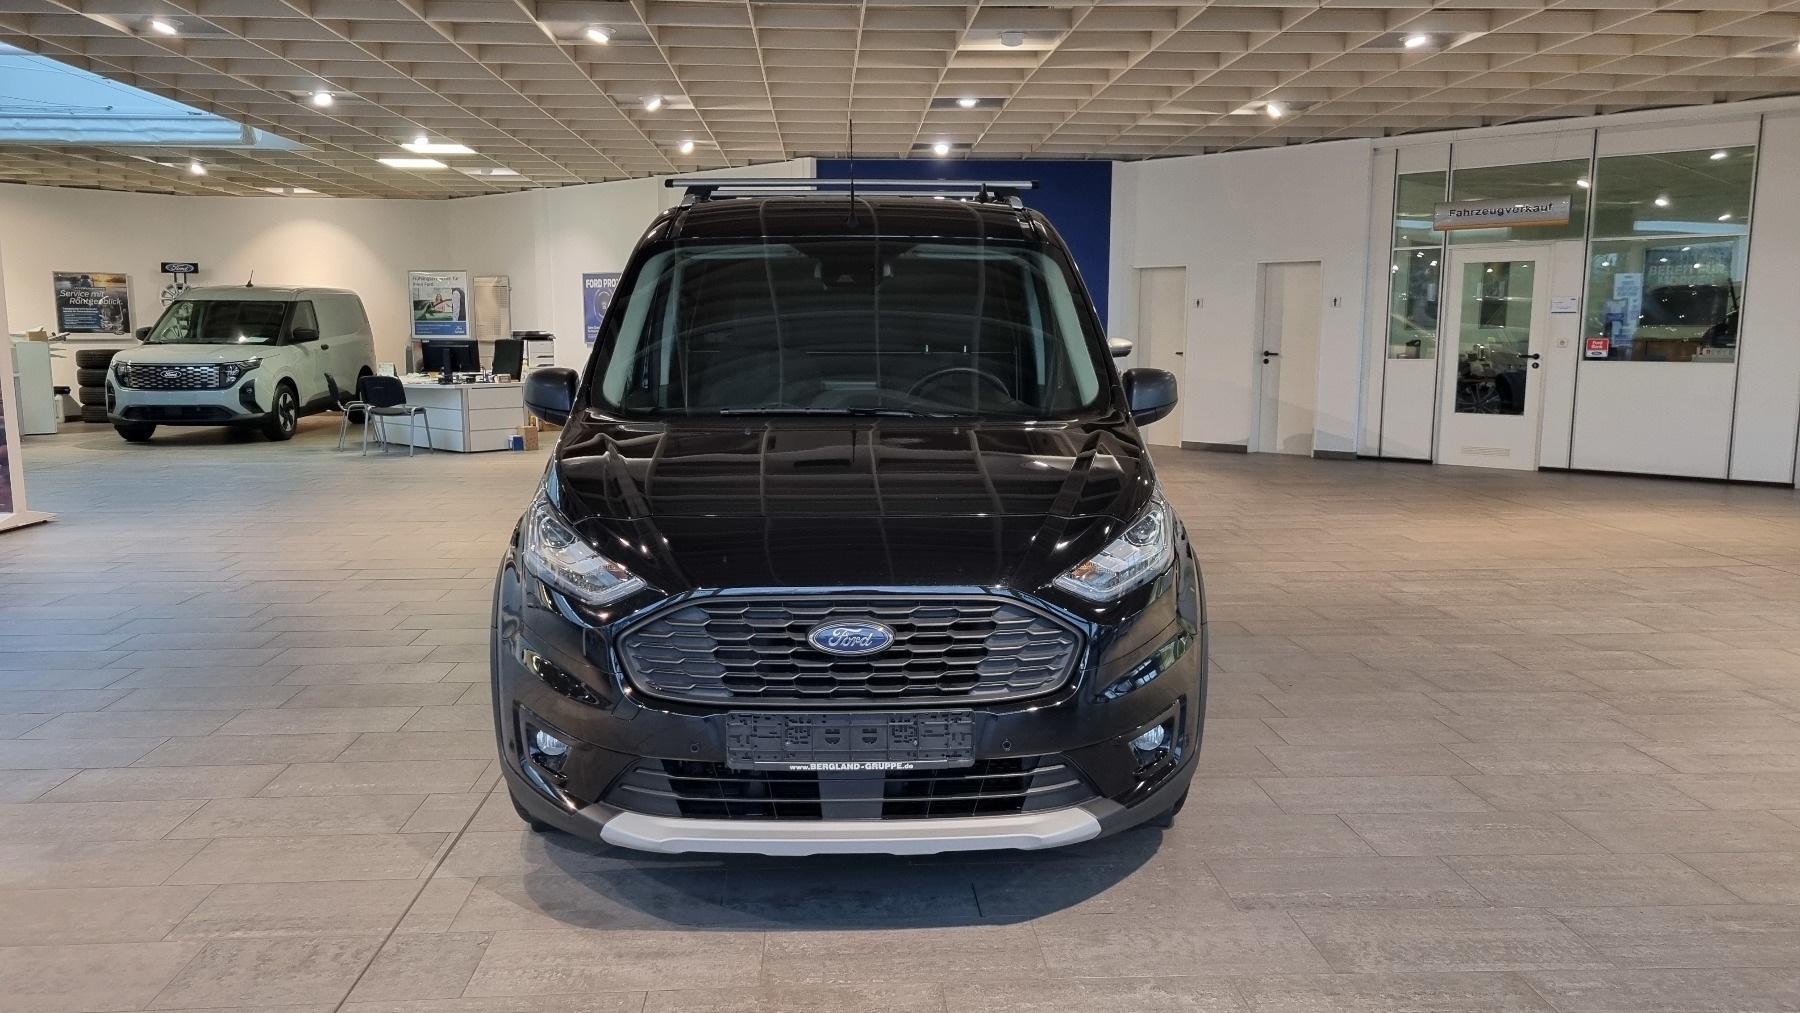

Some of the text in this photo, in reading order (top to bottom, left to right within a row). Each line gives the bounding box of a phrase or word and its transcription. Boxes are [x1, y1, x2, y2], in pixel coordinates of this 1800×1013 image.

[1449, 203, 1553, 217] Fahrzeugverkauf
[585, 278, 602, 288] FORD
[59, 289, 89, 297] Service
[828, 627, 873, 647] Ford
[789, 762, 913, 771] www.BERGLAND-GRUPPE.de
